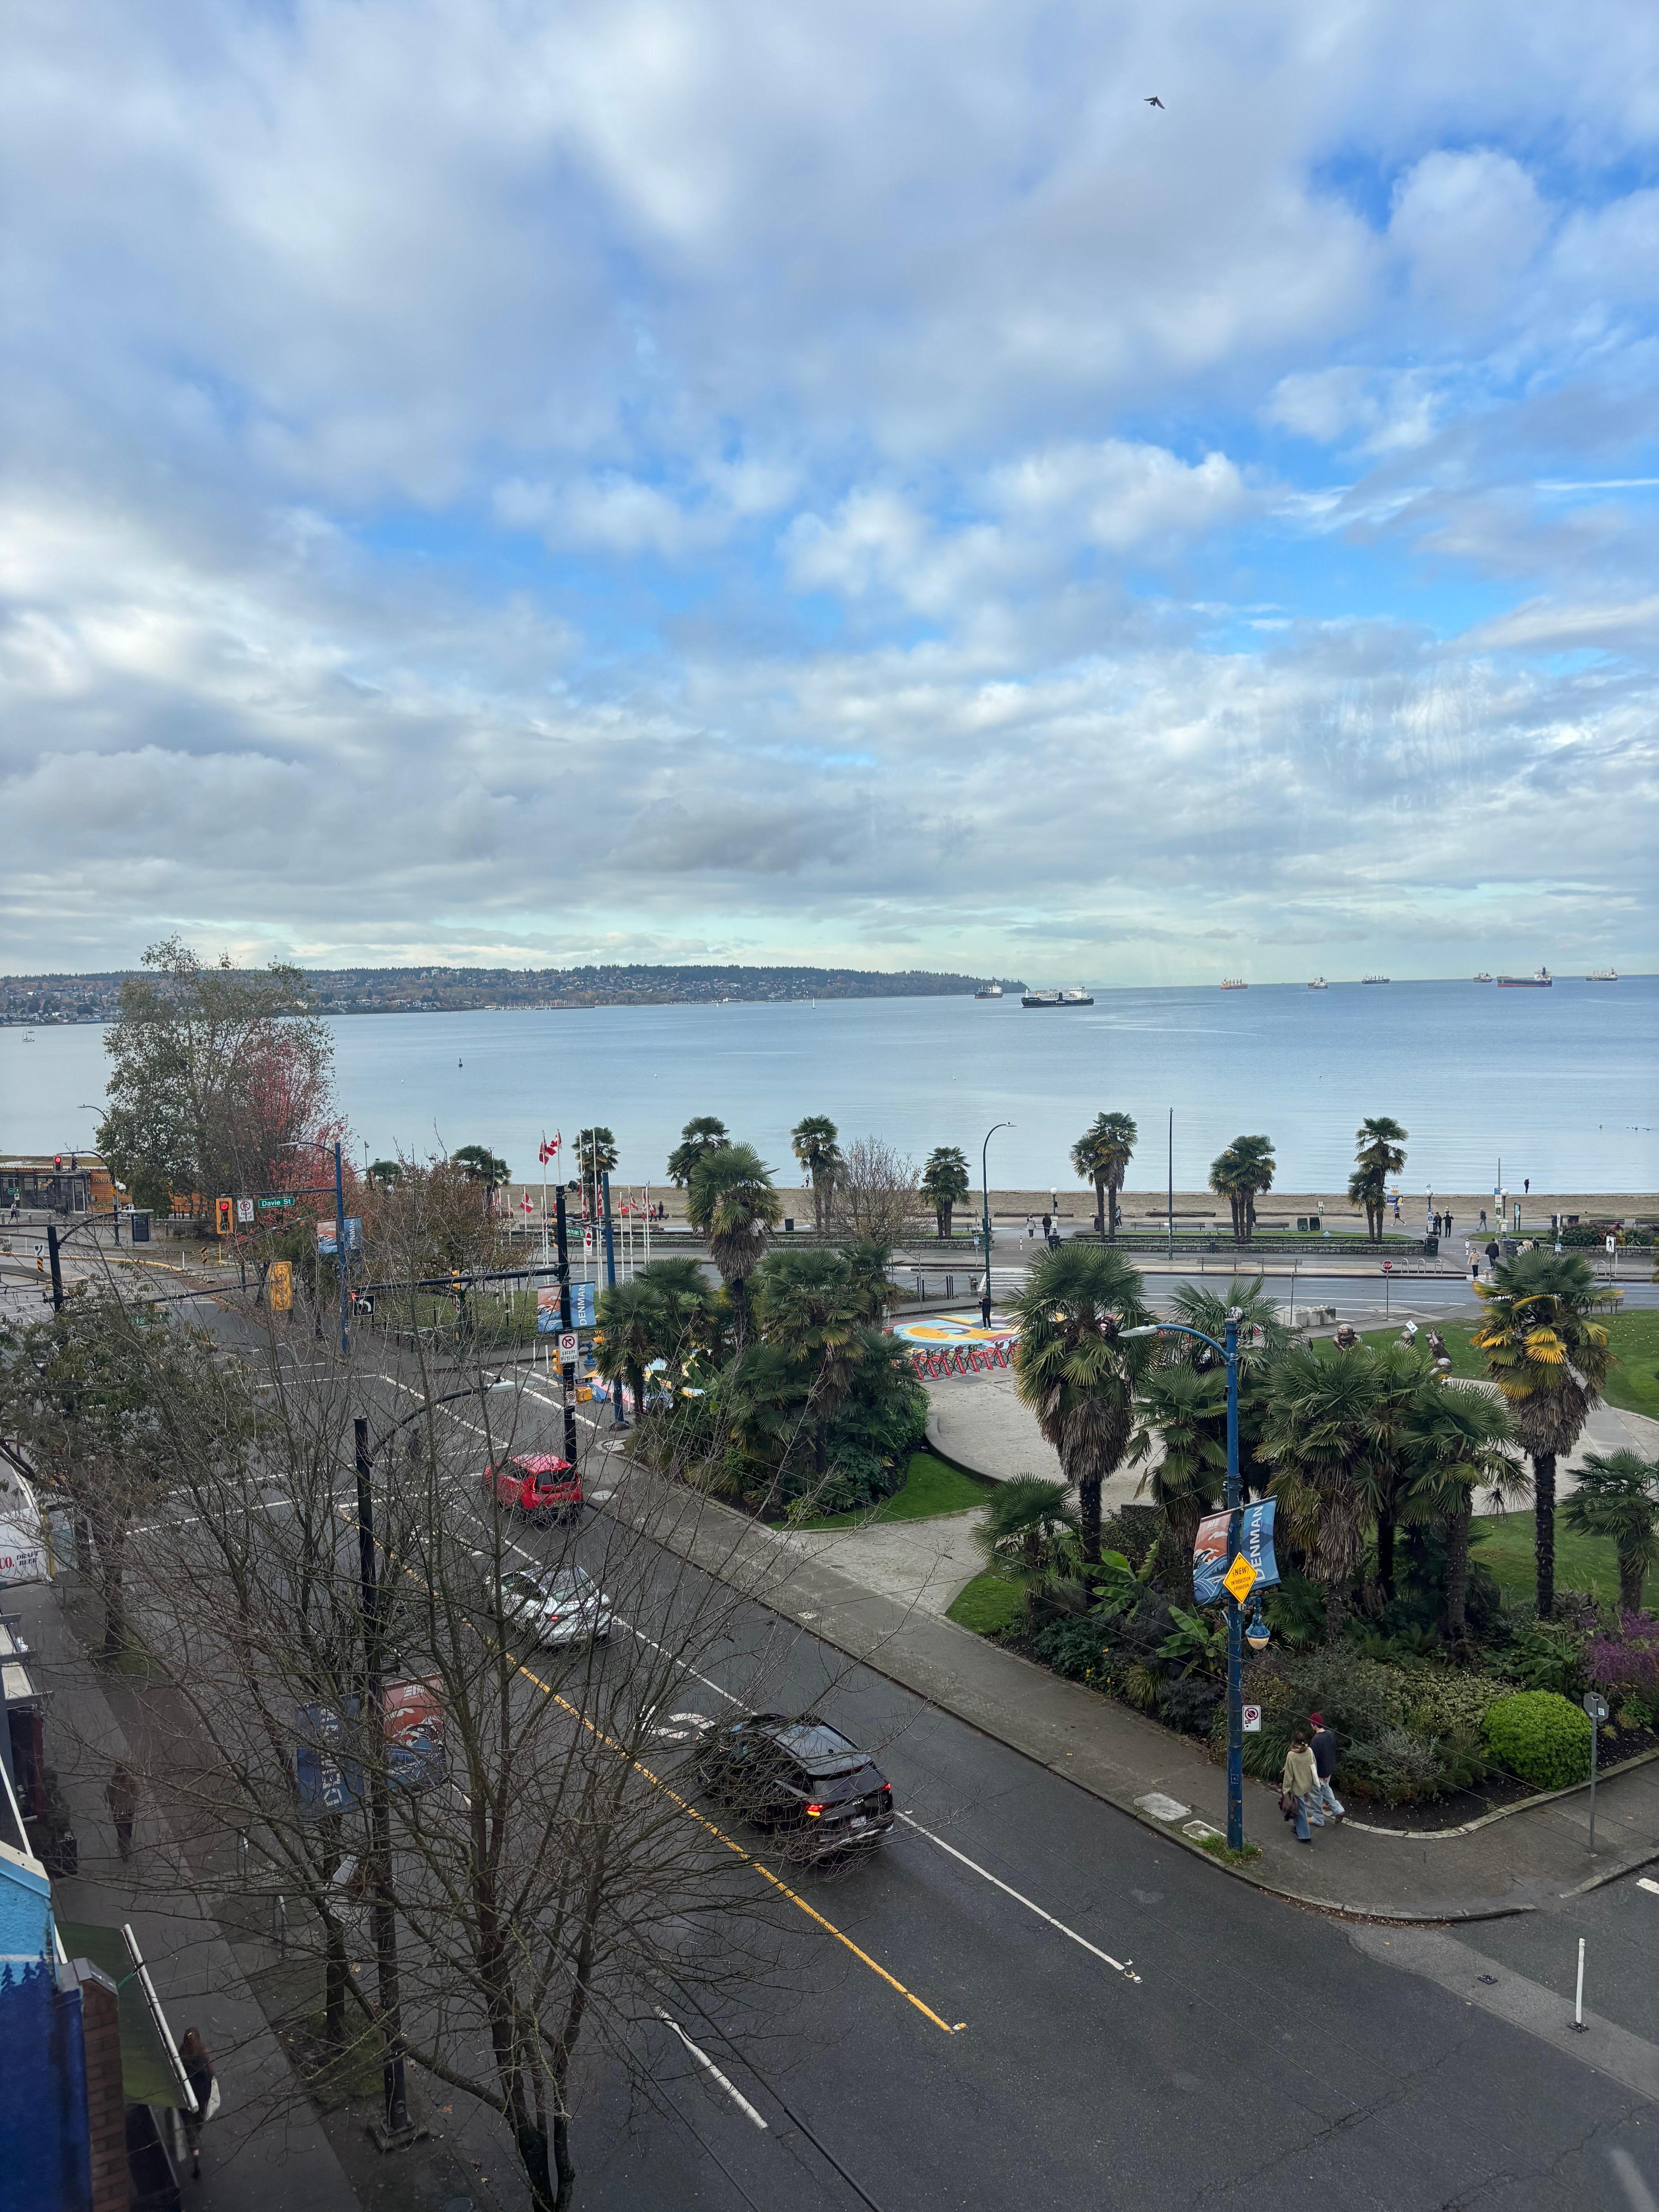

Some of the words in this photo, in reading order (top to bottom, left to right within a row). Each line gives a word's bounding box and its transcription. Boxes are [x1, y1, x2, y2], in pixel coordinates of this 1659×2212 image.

[577, 1284, 587, 1325] DENMAN
[1250, 1505, 1266, 1582] DENMAN
[1235, 1566, 1247, 1576] NEW
[1231, 1577, 1250, 1585] INTERSECTION
[1233, 1583, 1249, 1592] OPERATION
